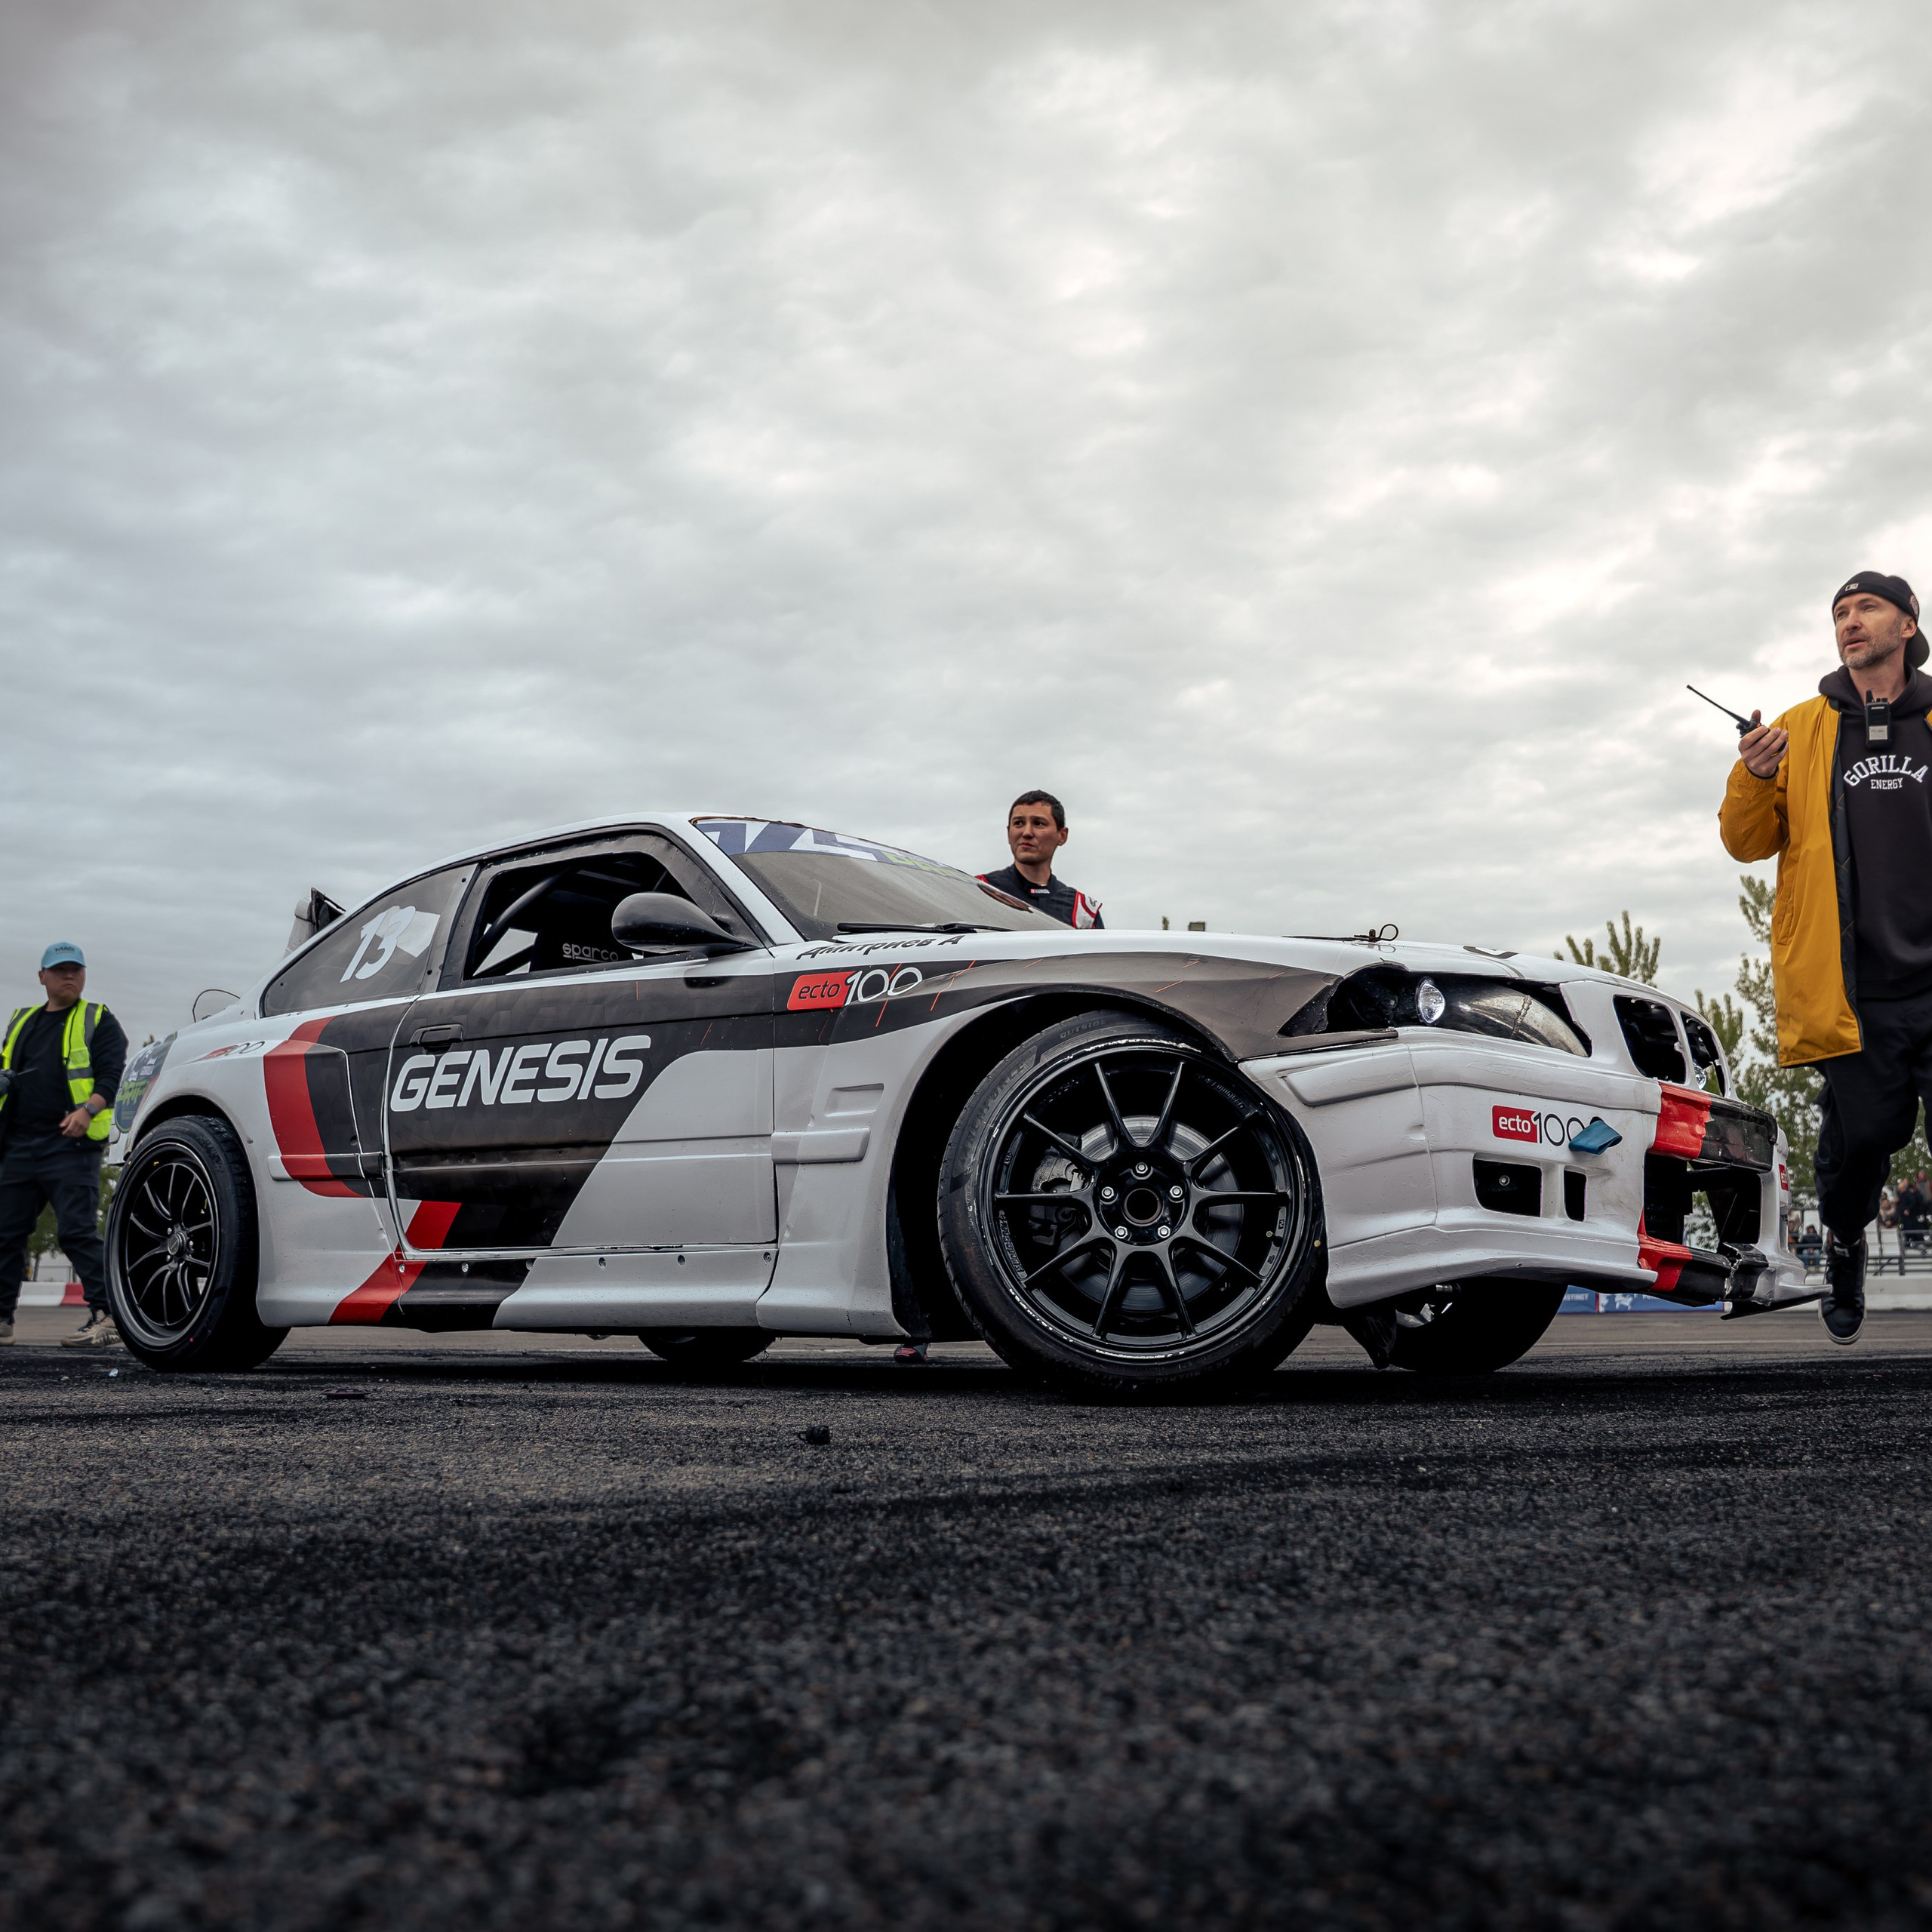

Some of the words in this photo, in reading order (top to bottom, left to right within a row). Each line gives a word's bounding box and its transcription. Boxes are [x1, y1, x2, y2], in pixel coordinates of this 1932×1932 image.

[1843, 755, 1929, 786] GORILLA
[1870, 778, 1903, 789] ENERGY
[340, 906, 416, 983] 13
[562, 943, 619, 961] sparco
[795, 938, 937, 960] Дмитриев
[390, 1035, 651, 1112] GENESIS
